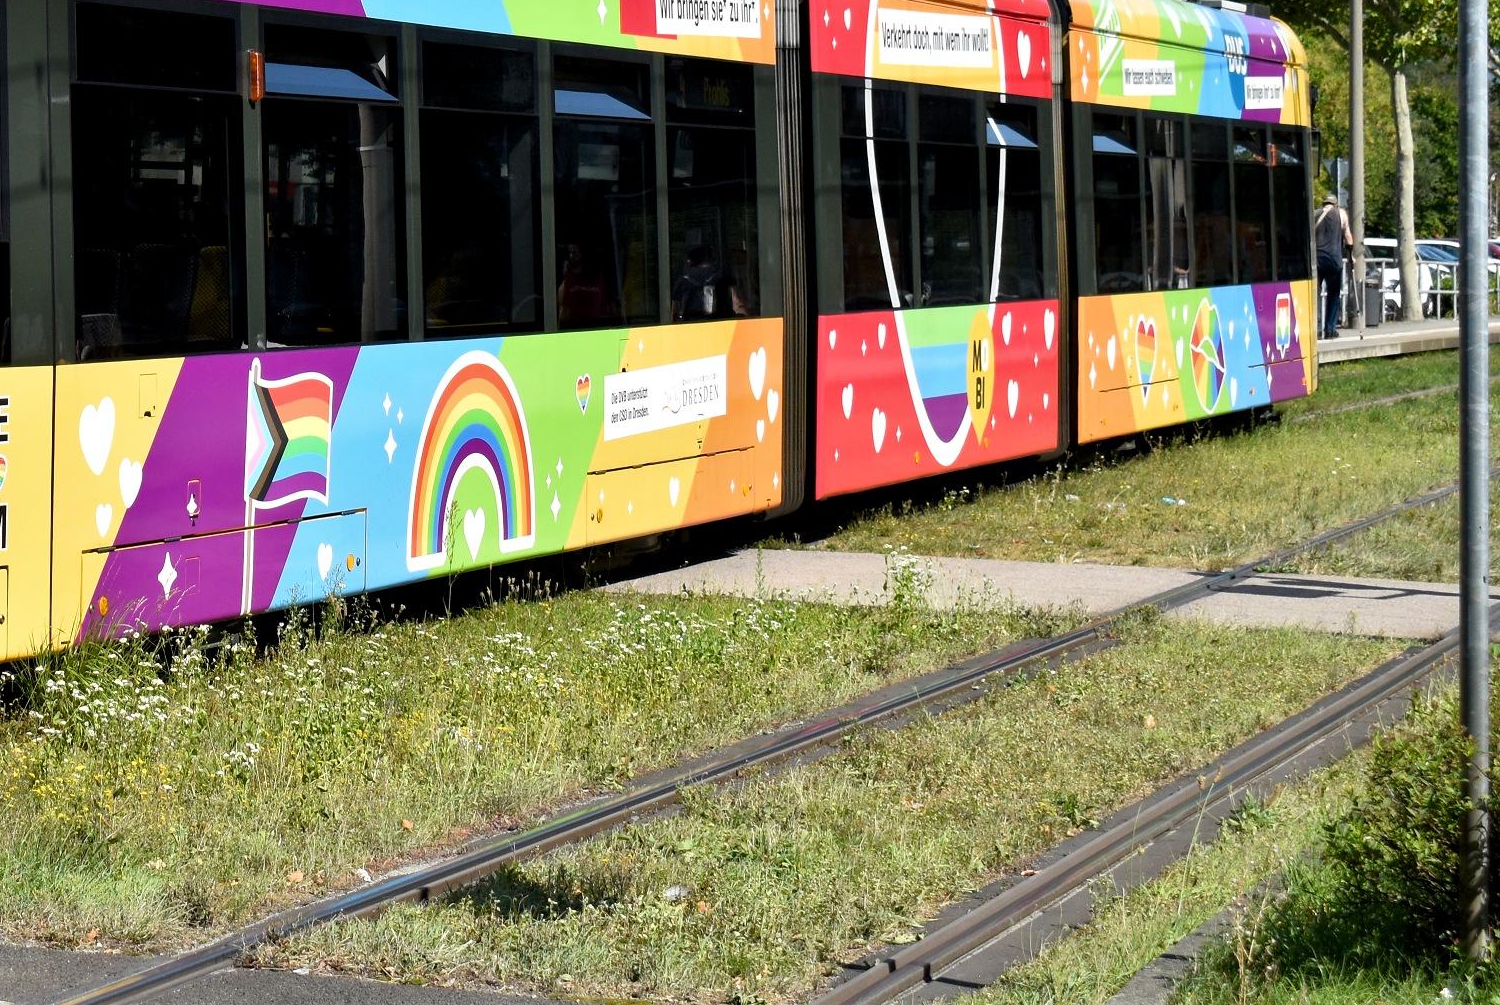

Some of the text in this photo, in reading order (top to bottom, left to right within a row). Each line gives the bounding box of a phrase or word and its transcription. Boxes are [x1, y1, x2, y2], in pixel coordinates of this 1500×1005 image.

[729, 2, 739, 22] zu
[881, 21, 989, 56] Verkehrt doch, mit wem ihr wollt!
[682, 384, 719, 407] DRESDEN
[975, 376, 985, 409] BI
